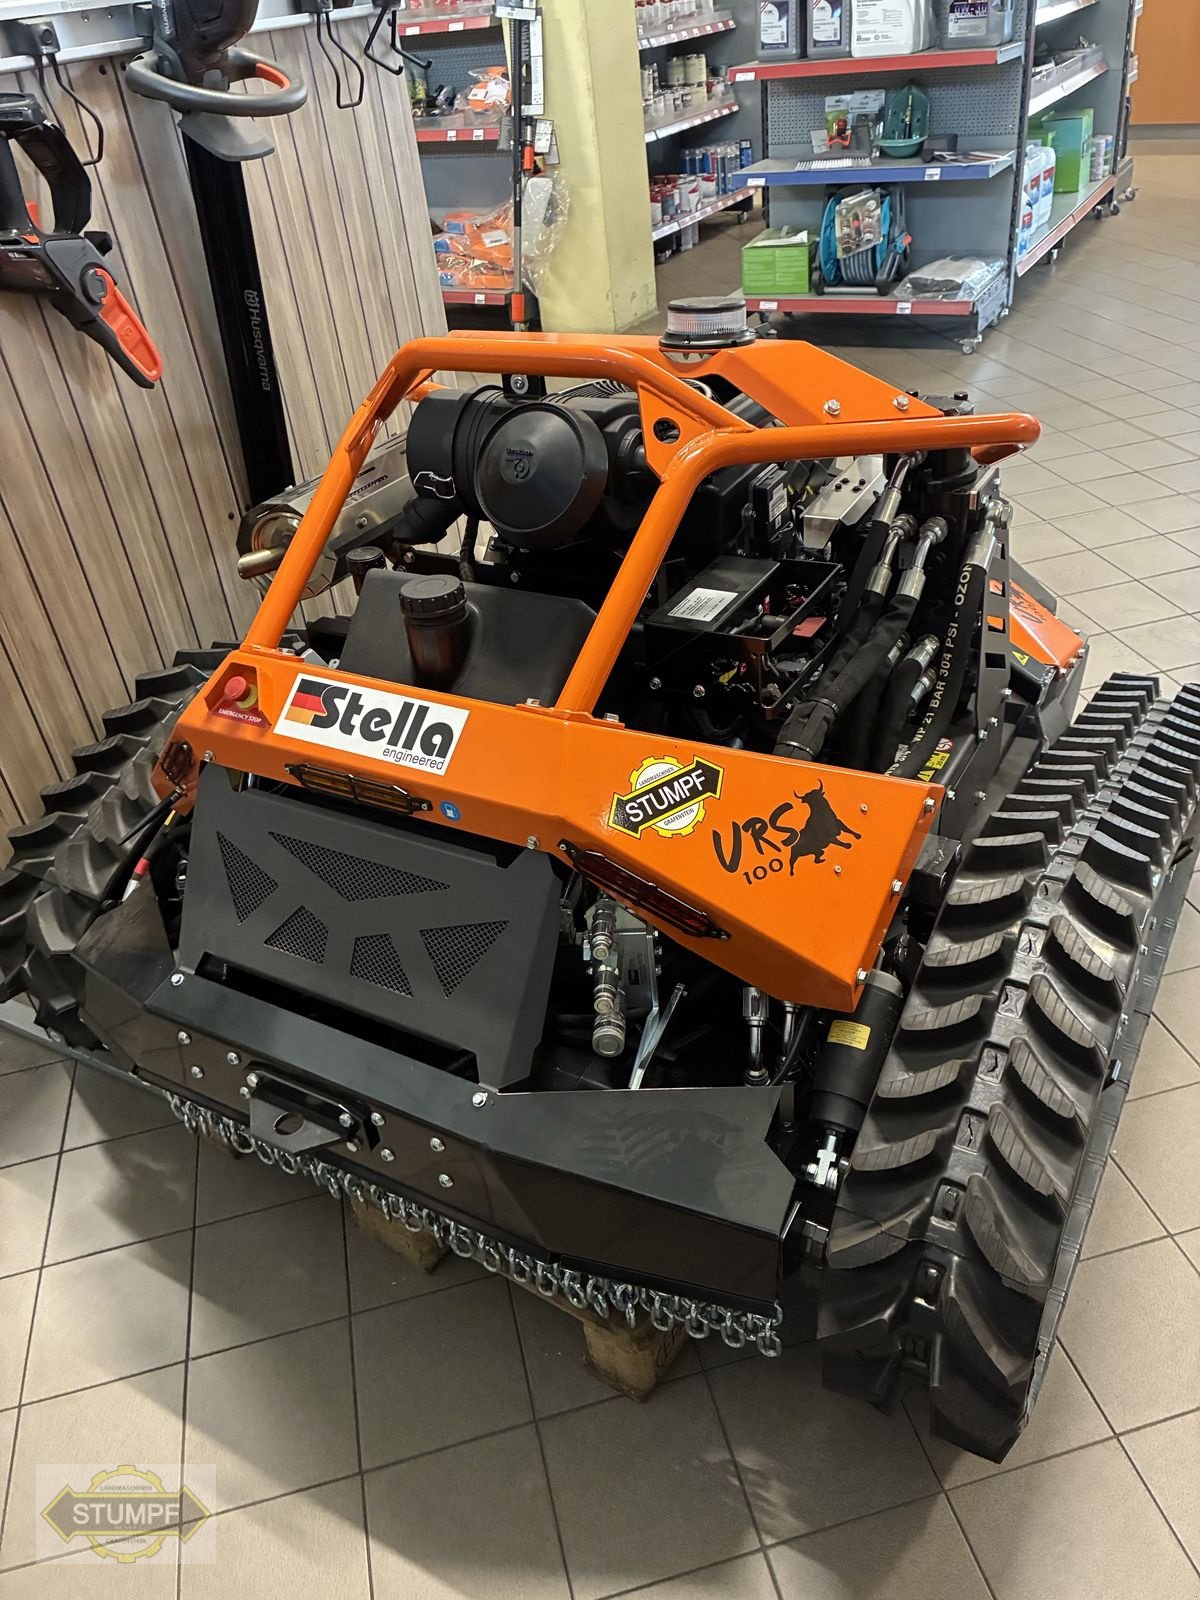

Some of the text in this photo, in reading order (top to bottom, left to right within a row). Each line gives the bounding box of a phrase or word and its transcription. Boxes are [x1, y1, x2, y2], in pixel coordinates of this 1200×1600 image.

[249, 307, 271, 391] Husqvarna
[945, 622, 958, 649] PSI
[939, 653, 952, 678] 304
[930, 681, 946, 708] BAR
[218, 708, 262, 723] EMERGENCY STOP
[310, 685, 455, 759] Stella
[382, 747, 445, 771] engineered
[638, 766, 675, 787] LANDMASCHINEN
[625, 769, 707, 823] STUMPF
[663, 808, 696, 827] GRAFENSTEIN
[712, 802, 800, 873] VRS
[743, 858, 784, 885] 100
